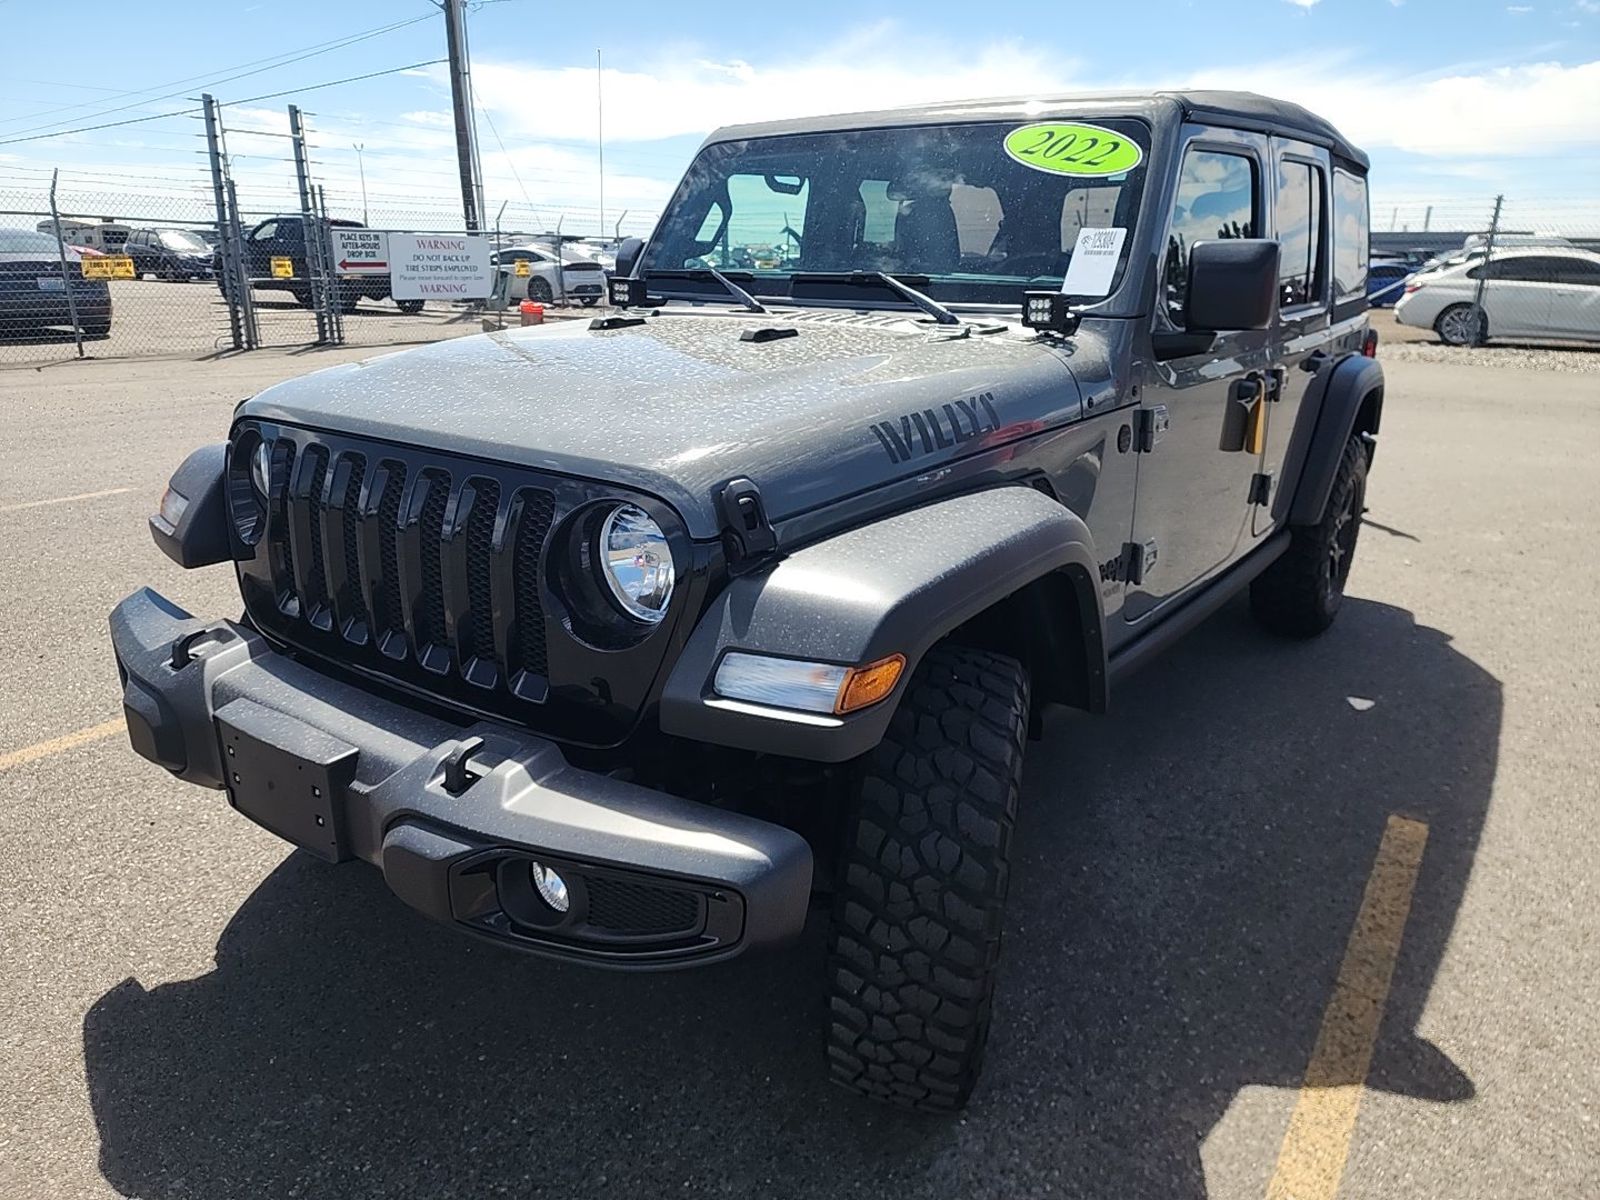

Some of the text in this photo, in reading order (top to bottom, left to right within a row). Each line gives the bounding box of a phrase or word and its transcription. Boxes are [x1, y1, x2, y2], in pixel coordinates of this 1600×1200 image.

[1019, 131, 1121, 166] 2022
[340, 233, 357, 241] PLACE
[416, 239, 465, 251] WARNING
[347, 250, 363, 258] DROP
[413, 254, 424, 262] DO
[443, 254, 459, 262] BACK
[406, 264, 420, 272] TIRE
[419, 284, 467, 294] WARNING
[869, 392, 1000, 464] WILLYS
